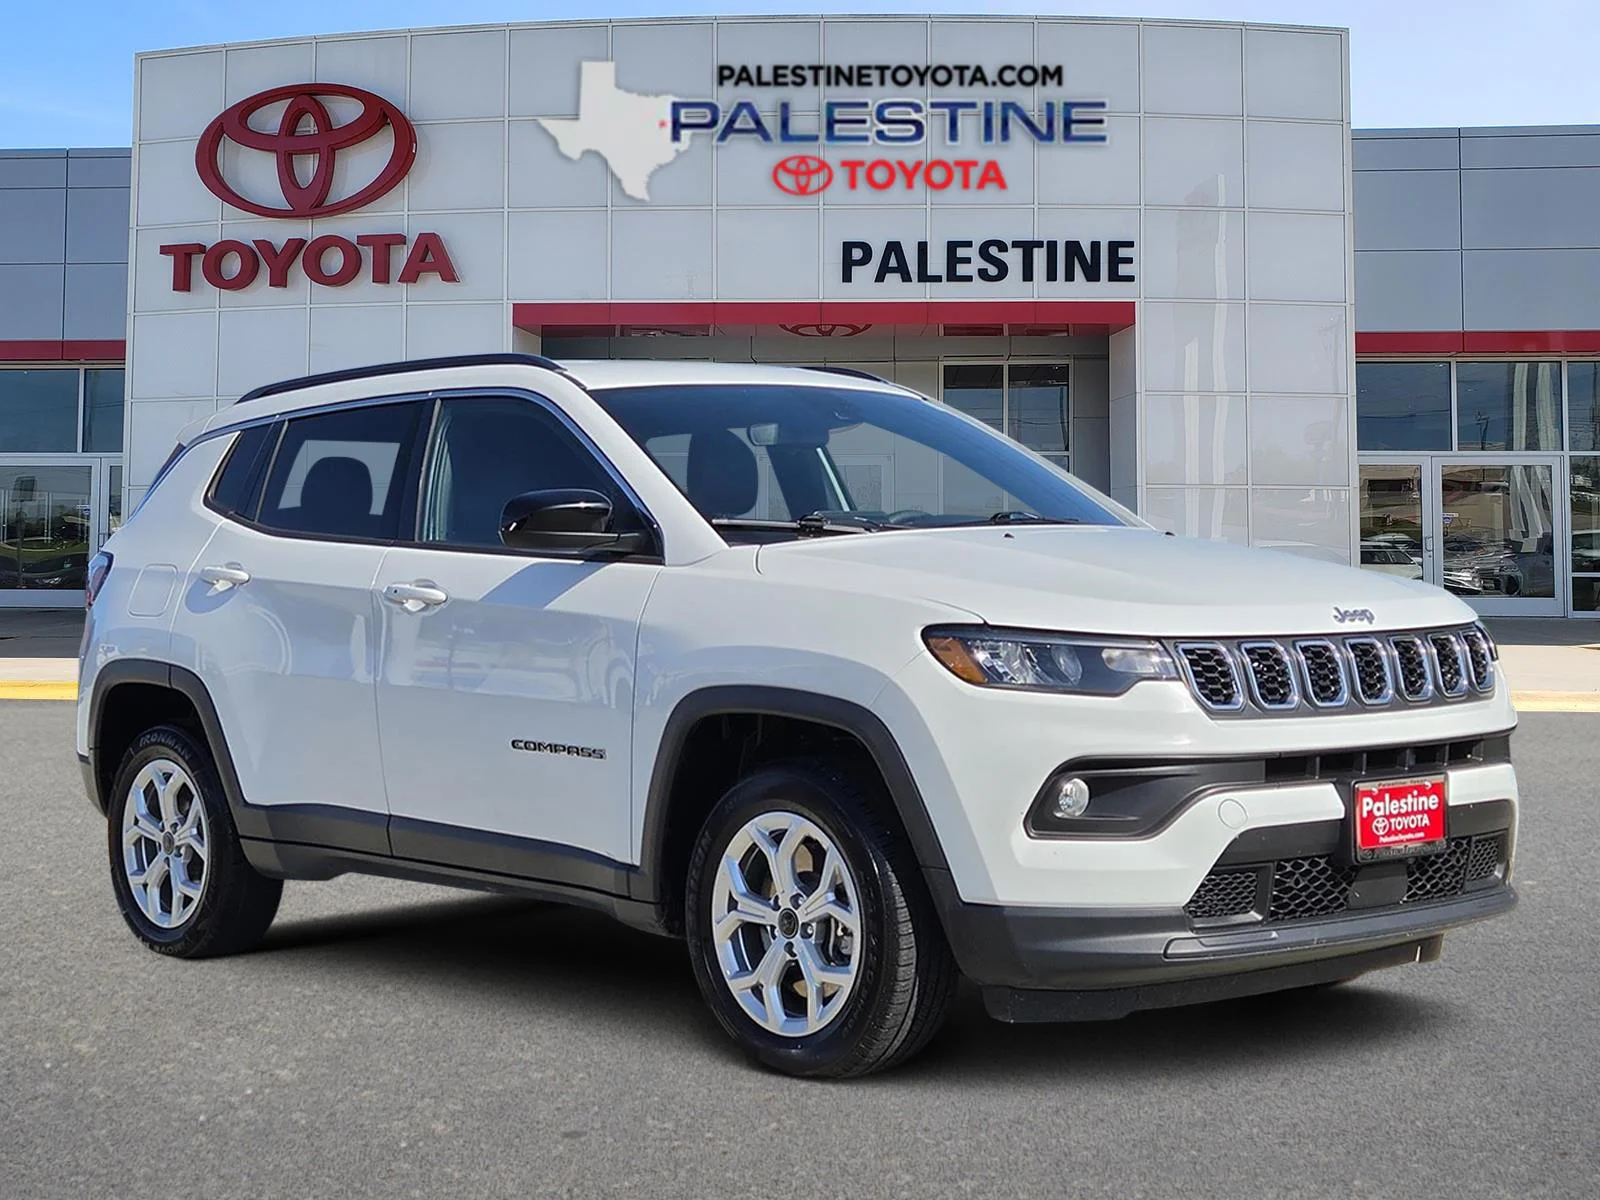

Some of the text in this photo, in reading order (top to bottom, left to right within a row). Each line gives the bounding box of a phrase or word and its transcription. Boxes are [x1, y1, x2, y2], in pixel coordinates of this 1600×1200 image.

[159, 232, 460, 292] TOYOTA
[841, 239, 1136, 284] PALESTINE
[1333, 606, 1376, 625] Jeep
[511, 739, 606, 760] COMPASS
[1362, 789, 1439, 818] Palestine
[1390, 814, 1430, 830] TOYOTA
